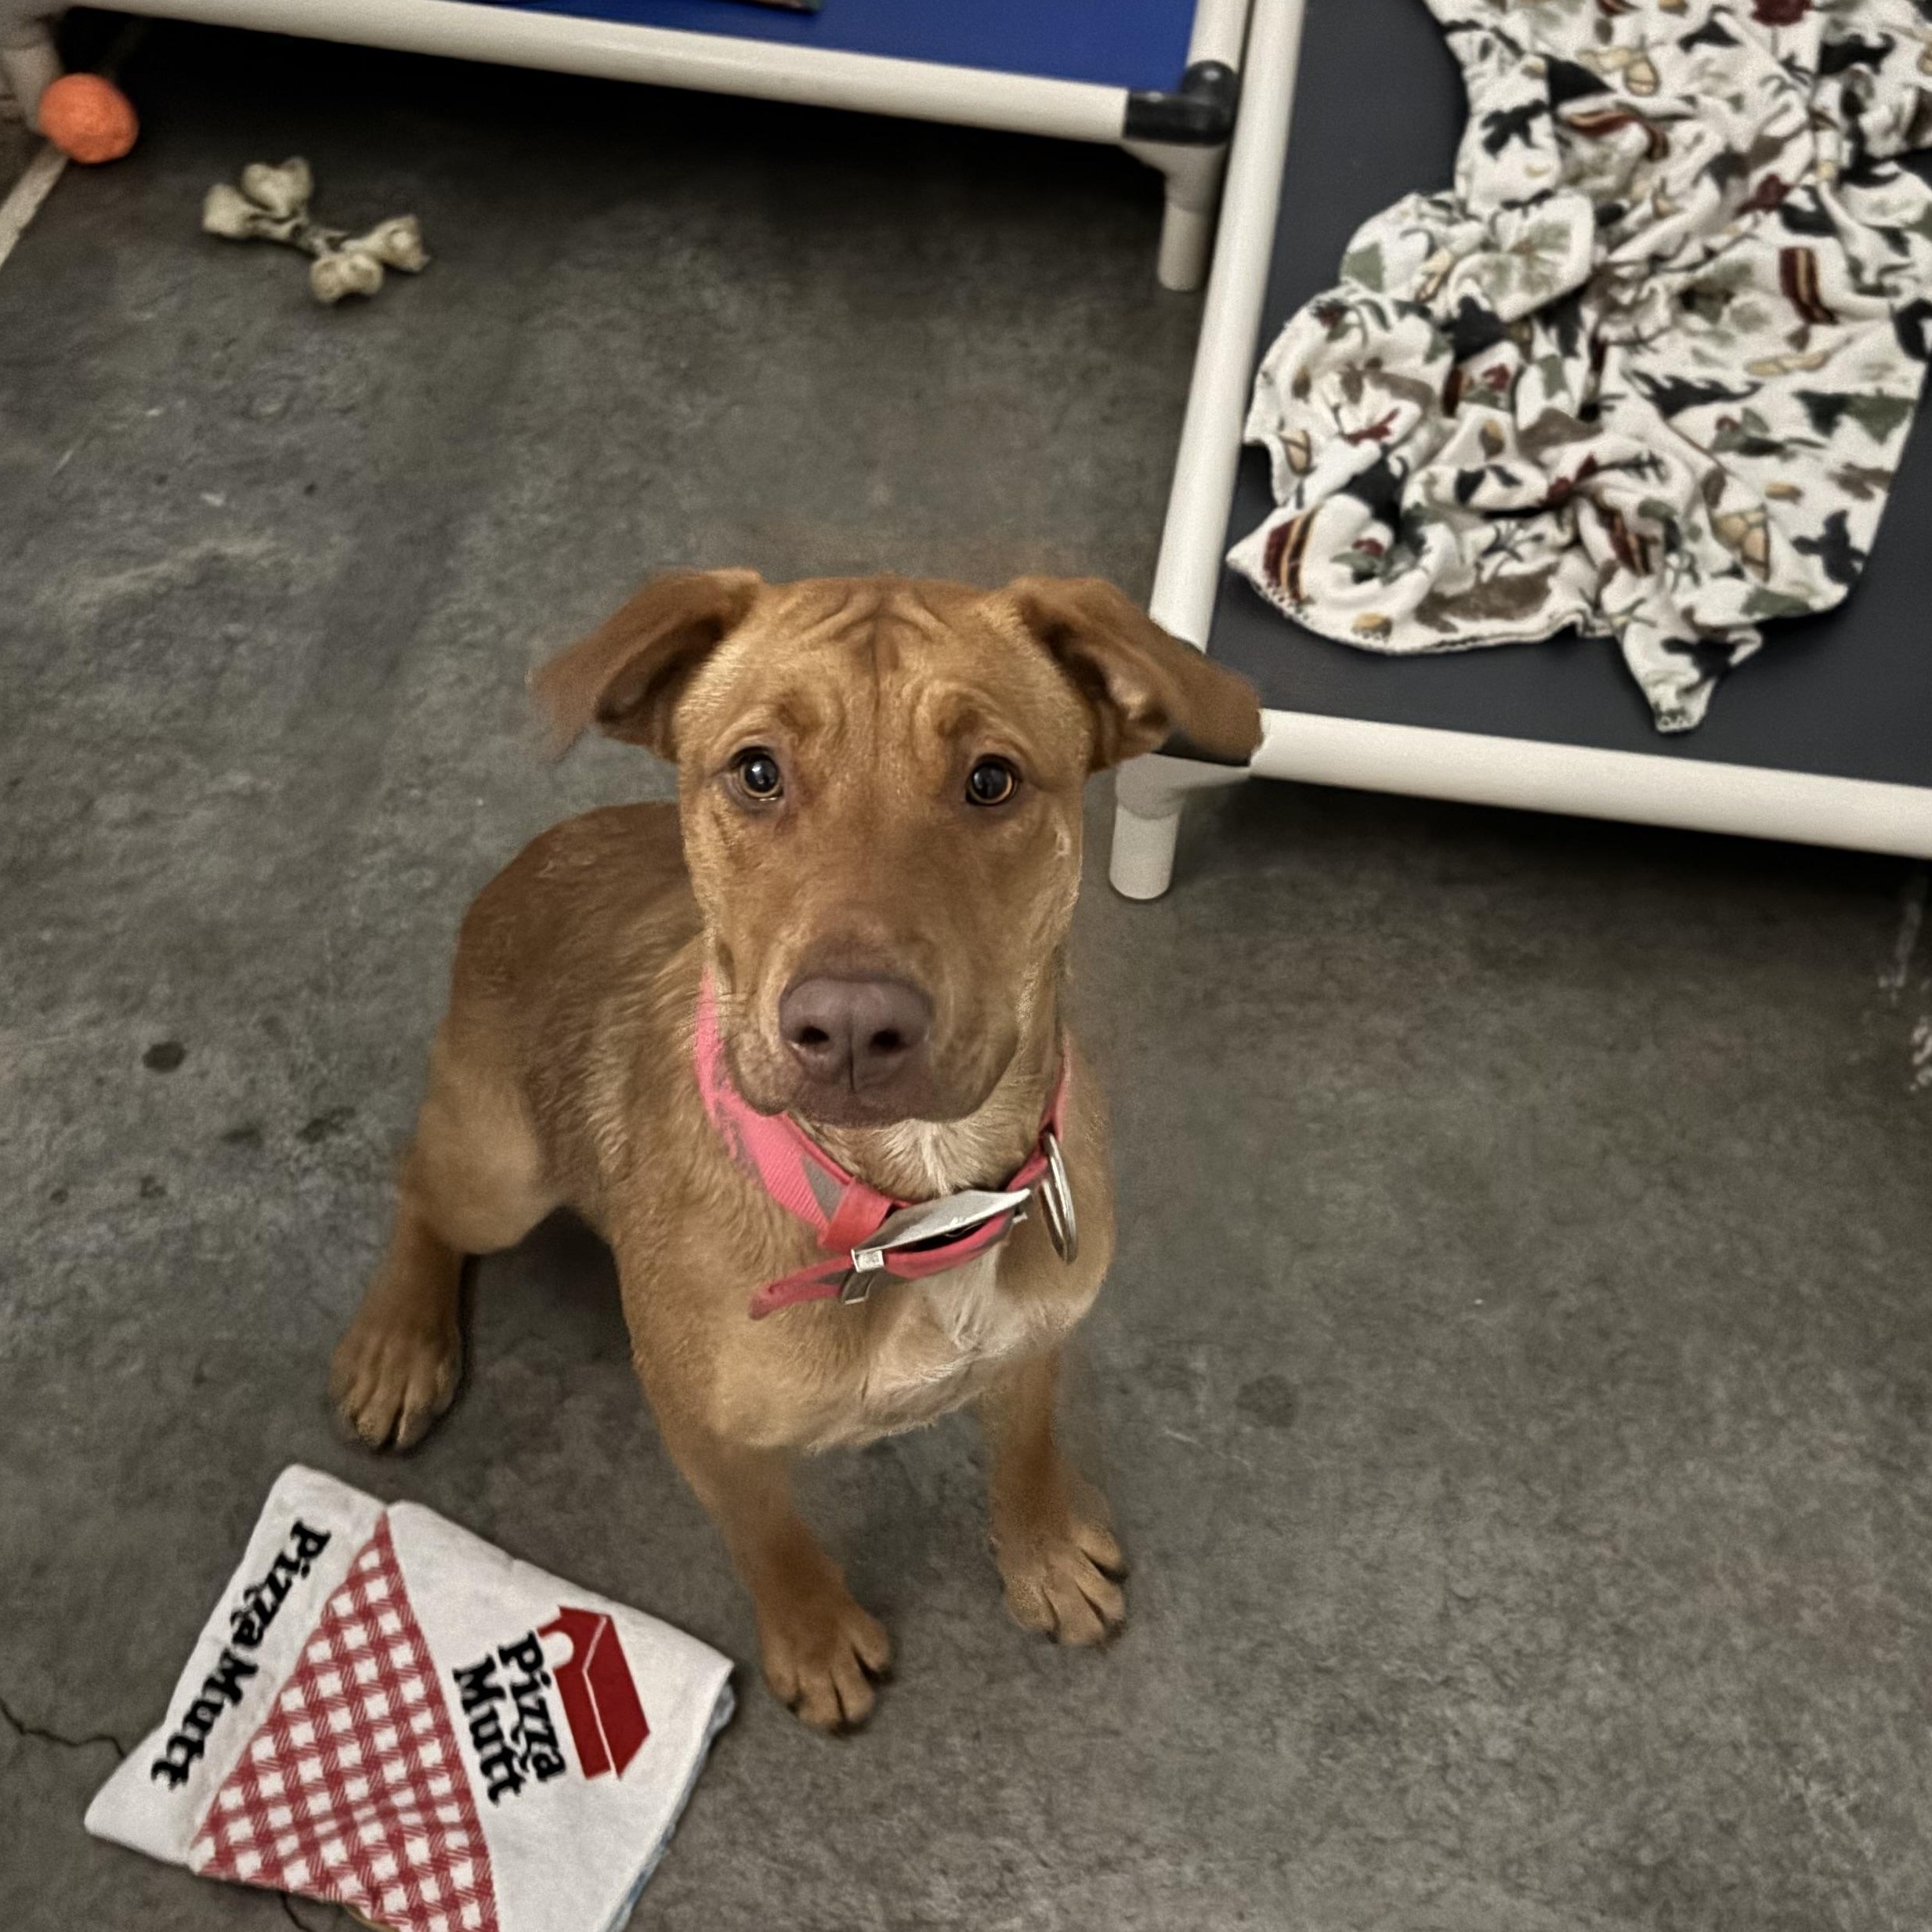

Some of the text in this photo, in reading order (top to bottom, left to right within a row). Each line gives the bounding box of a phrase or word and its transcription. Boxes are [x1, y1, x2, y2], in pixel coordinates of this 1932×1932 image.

[151, 1521, 331, 1792] Pizza Mutt
[453, 1654, 526, 1807] Mutt
[498, 1630, 566, 1782] Pizza
